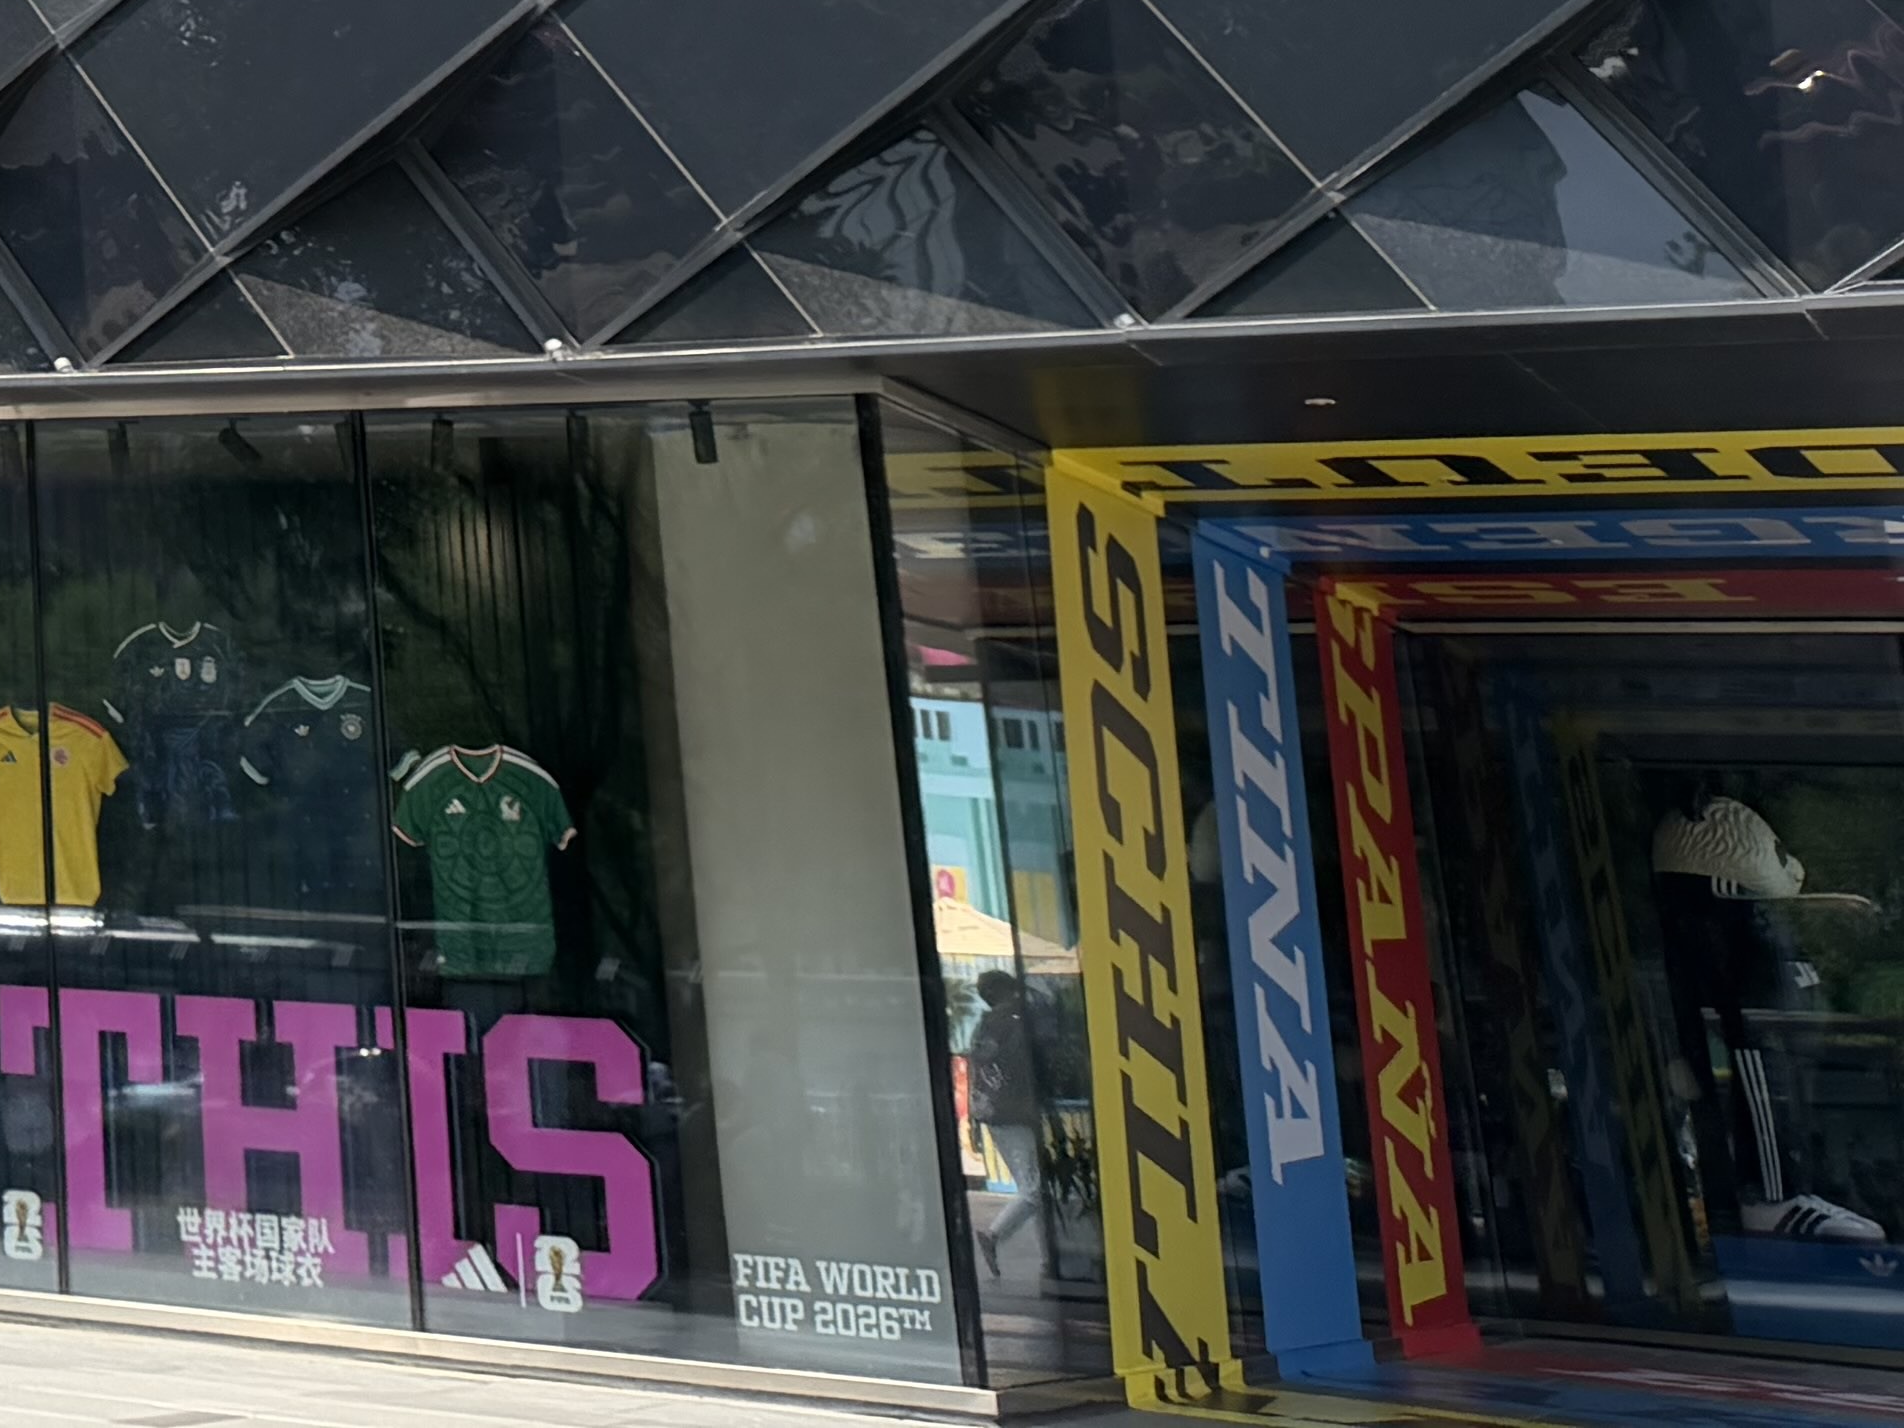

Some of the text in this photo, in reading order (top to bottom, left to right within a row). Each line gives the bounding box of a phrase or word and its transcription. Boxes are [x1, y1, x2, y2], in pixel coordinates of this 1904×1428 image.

[1213, 558, 1325, 1186] TINA
[177, 1207, 335, 1254] 世界杯国家队
[192, 1244, 324, 1289] 主客场球衣
[733, 1253, 941, 1304] FIFA WORLD
[738, 1294, 805, 1332] CUP
